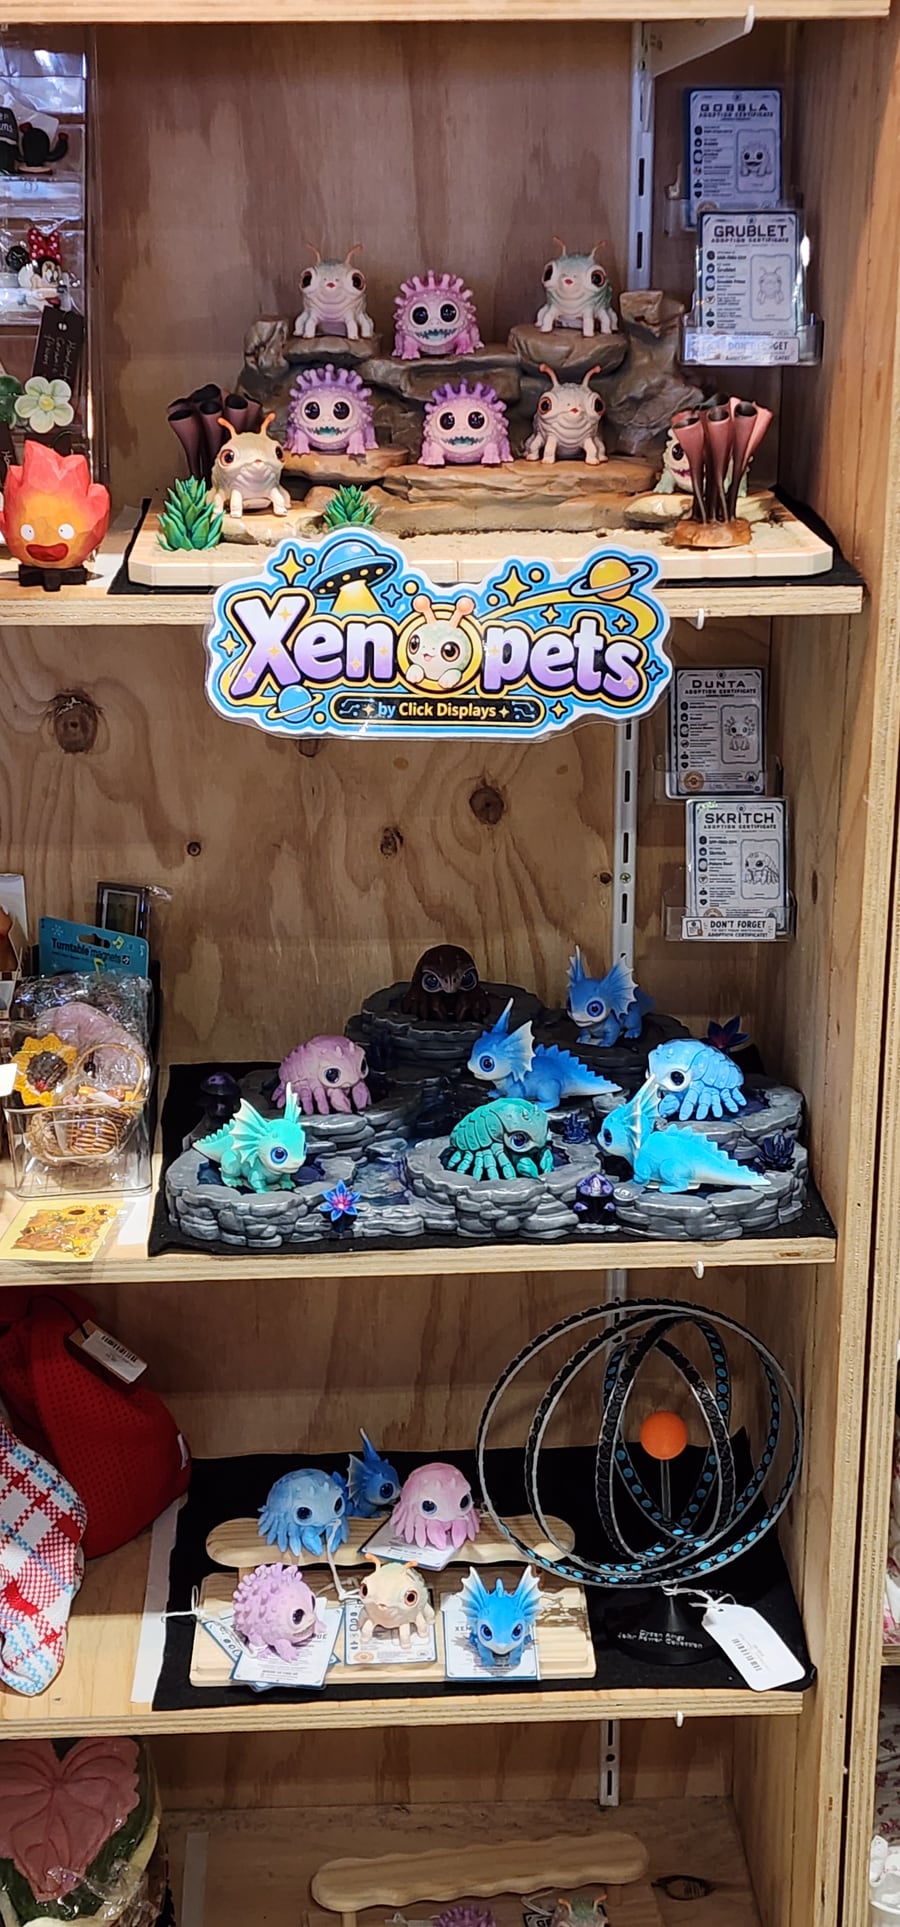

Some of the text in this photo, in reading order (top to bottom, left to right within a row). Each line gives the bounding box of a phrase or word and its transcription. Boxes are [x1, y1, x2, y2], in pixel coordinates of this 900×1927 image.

[714, 225, 787, 237] GRUBLET
[692, 680, 746, 688] DUNTA
[378, 701, 497, 720] by Click Displays
[705, 812, 774, 824] SKRITCH
[710, 920, 766, 928] DON'T FORGET
